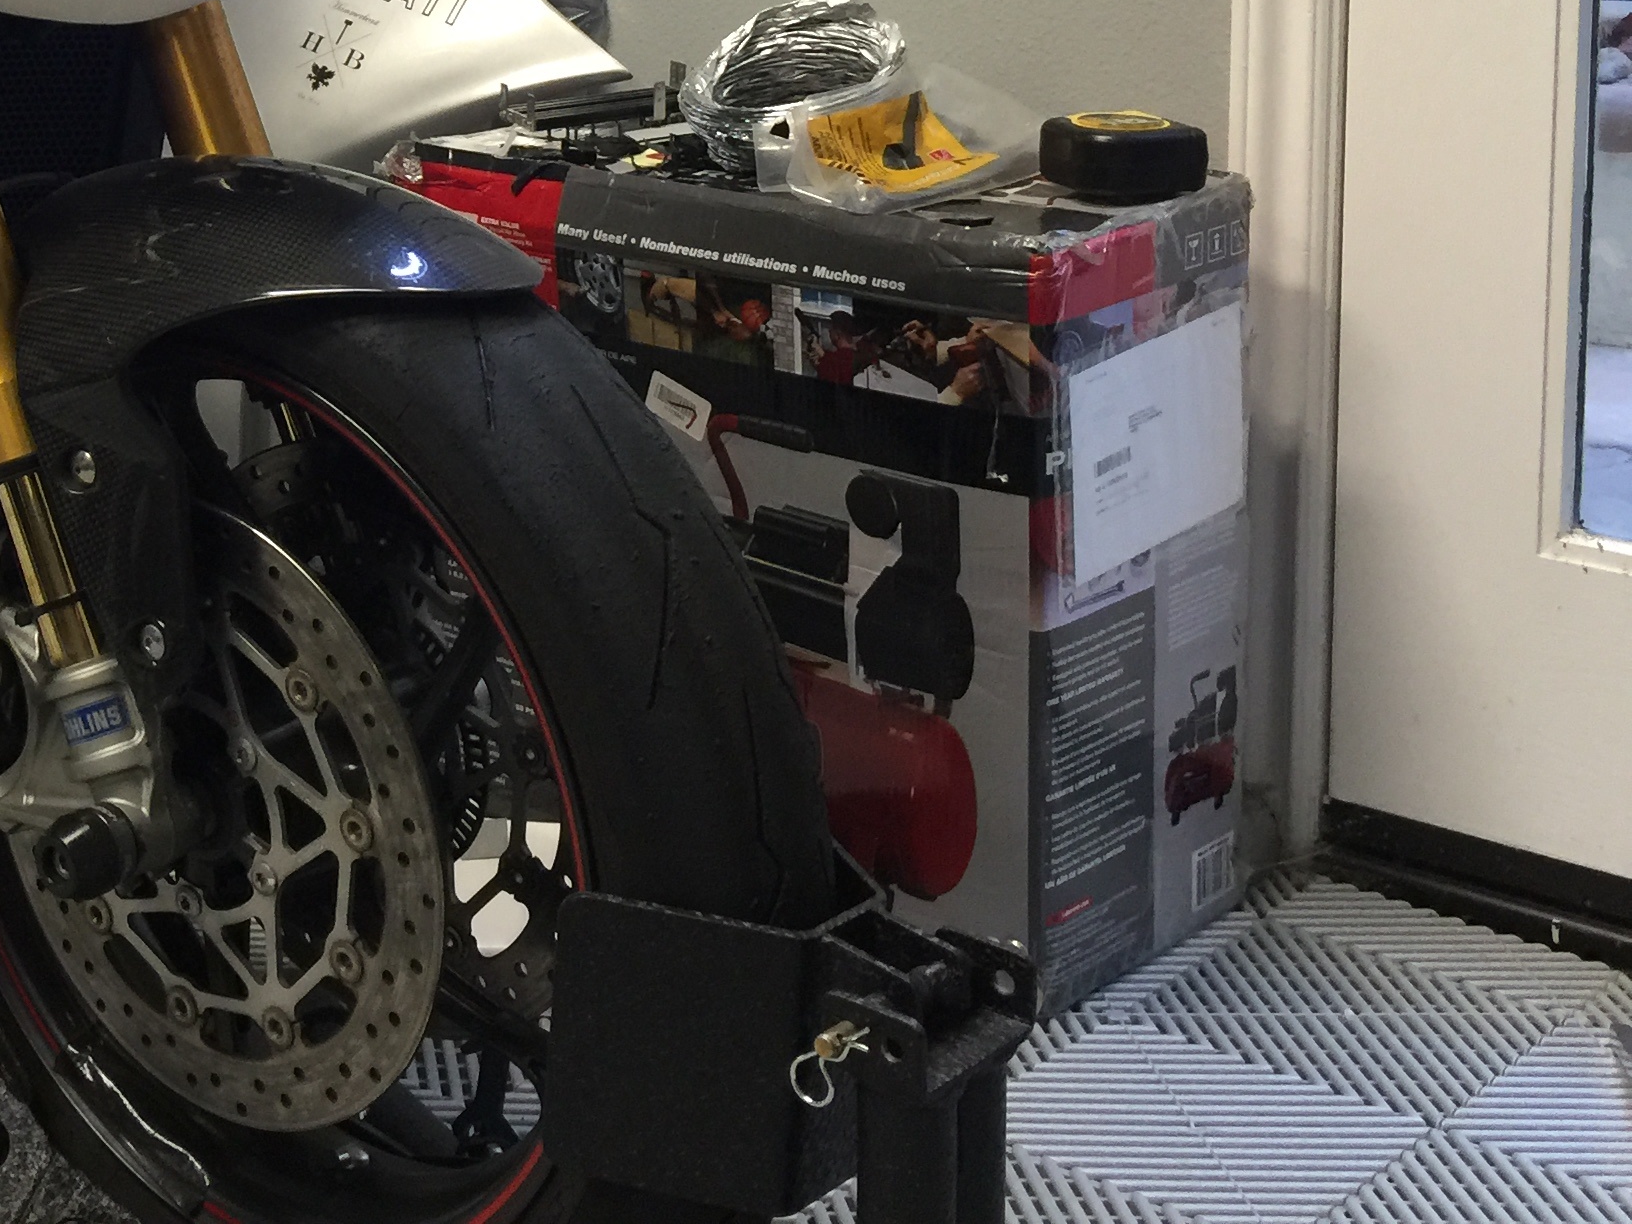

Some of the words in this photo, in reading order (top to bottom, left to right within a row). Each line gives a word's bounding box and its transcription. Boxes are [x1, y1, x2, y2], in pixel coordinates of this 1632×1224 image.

[300, 31, 325, 54] H
[343, 48, 365, 70] B
[557, 223, 589, 241] Many
[593, 228, 627, 246] Uses!
[639, 236, 720, 262] Nombreuses
[722, 251, 797, 275] utilisations
[812, 265, 867, 286] Muchos
[871, 276, 906, 292] usos
[64, 705, 121, 739] HLINS
